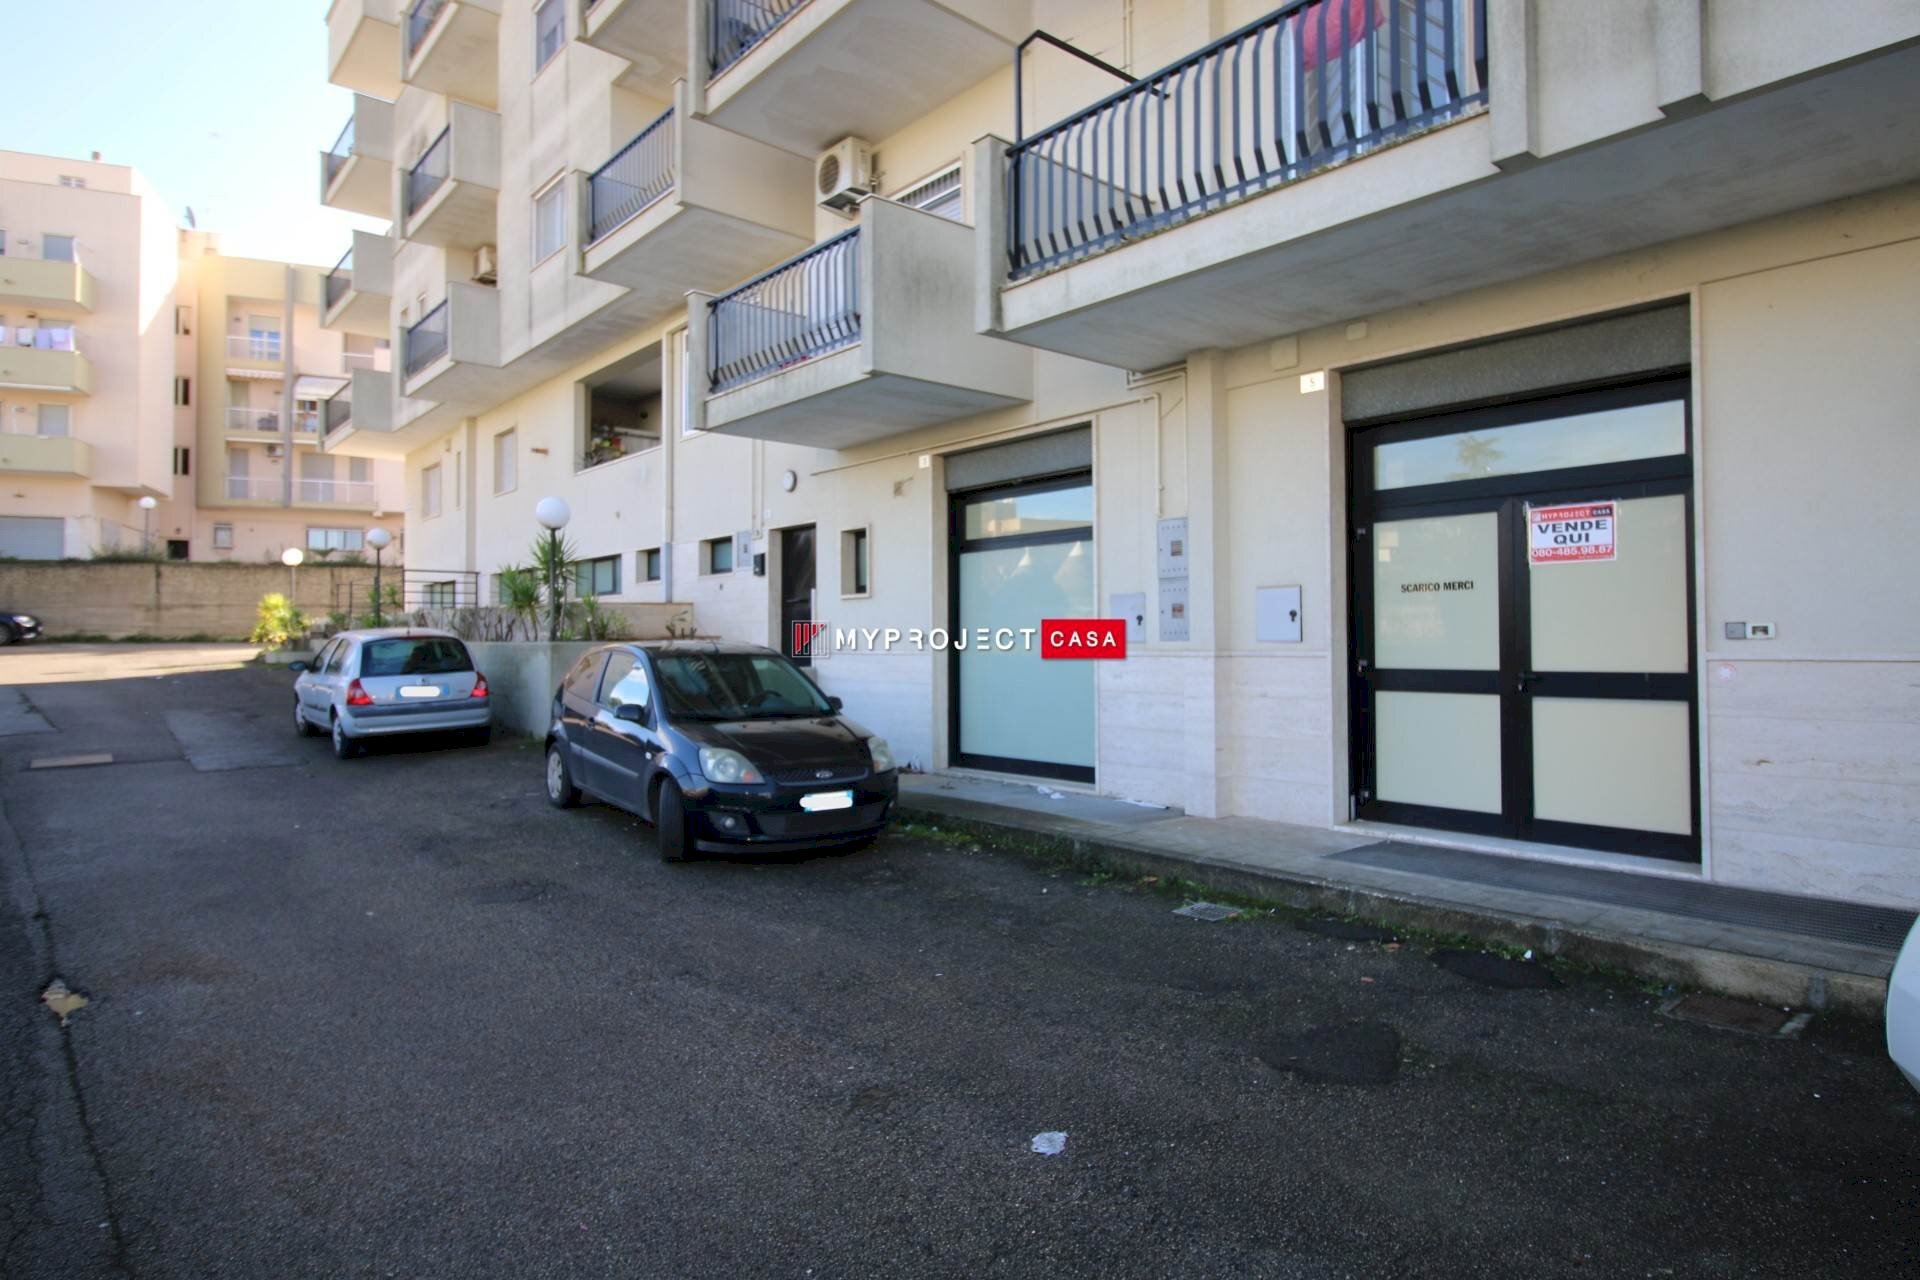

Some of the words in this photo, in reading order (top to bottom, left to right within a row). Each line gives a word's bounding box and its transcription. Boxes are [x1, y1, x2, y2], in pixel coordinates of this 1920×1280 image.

[1537, 519, 1608, 534] VENDE
[1553, 532, 1590, 545] QUI
[1401, 582, 1441, 593] SCARICO
[1443, 580, 1474, 591] MERCI
